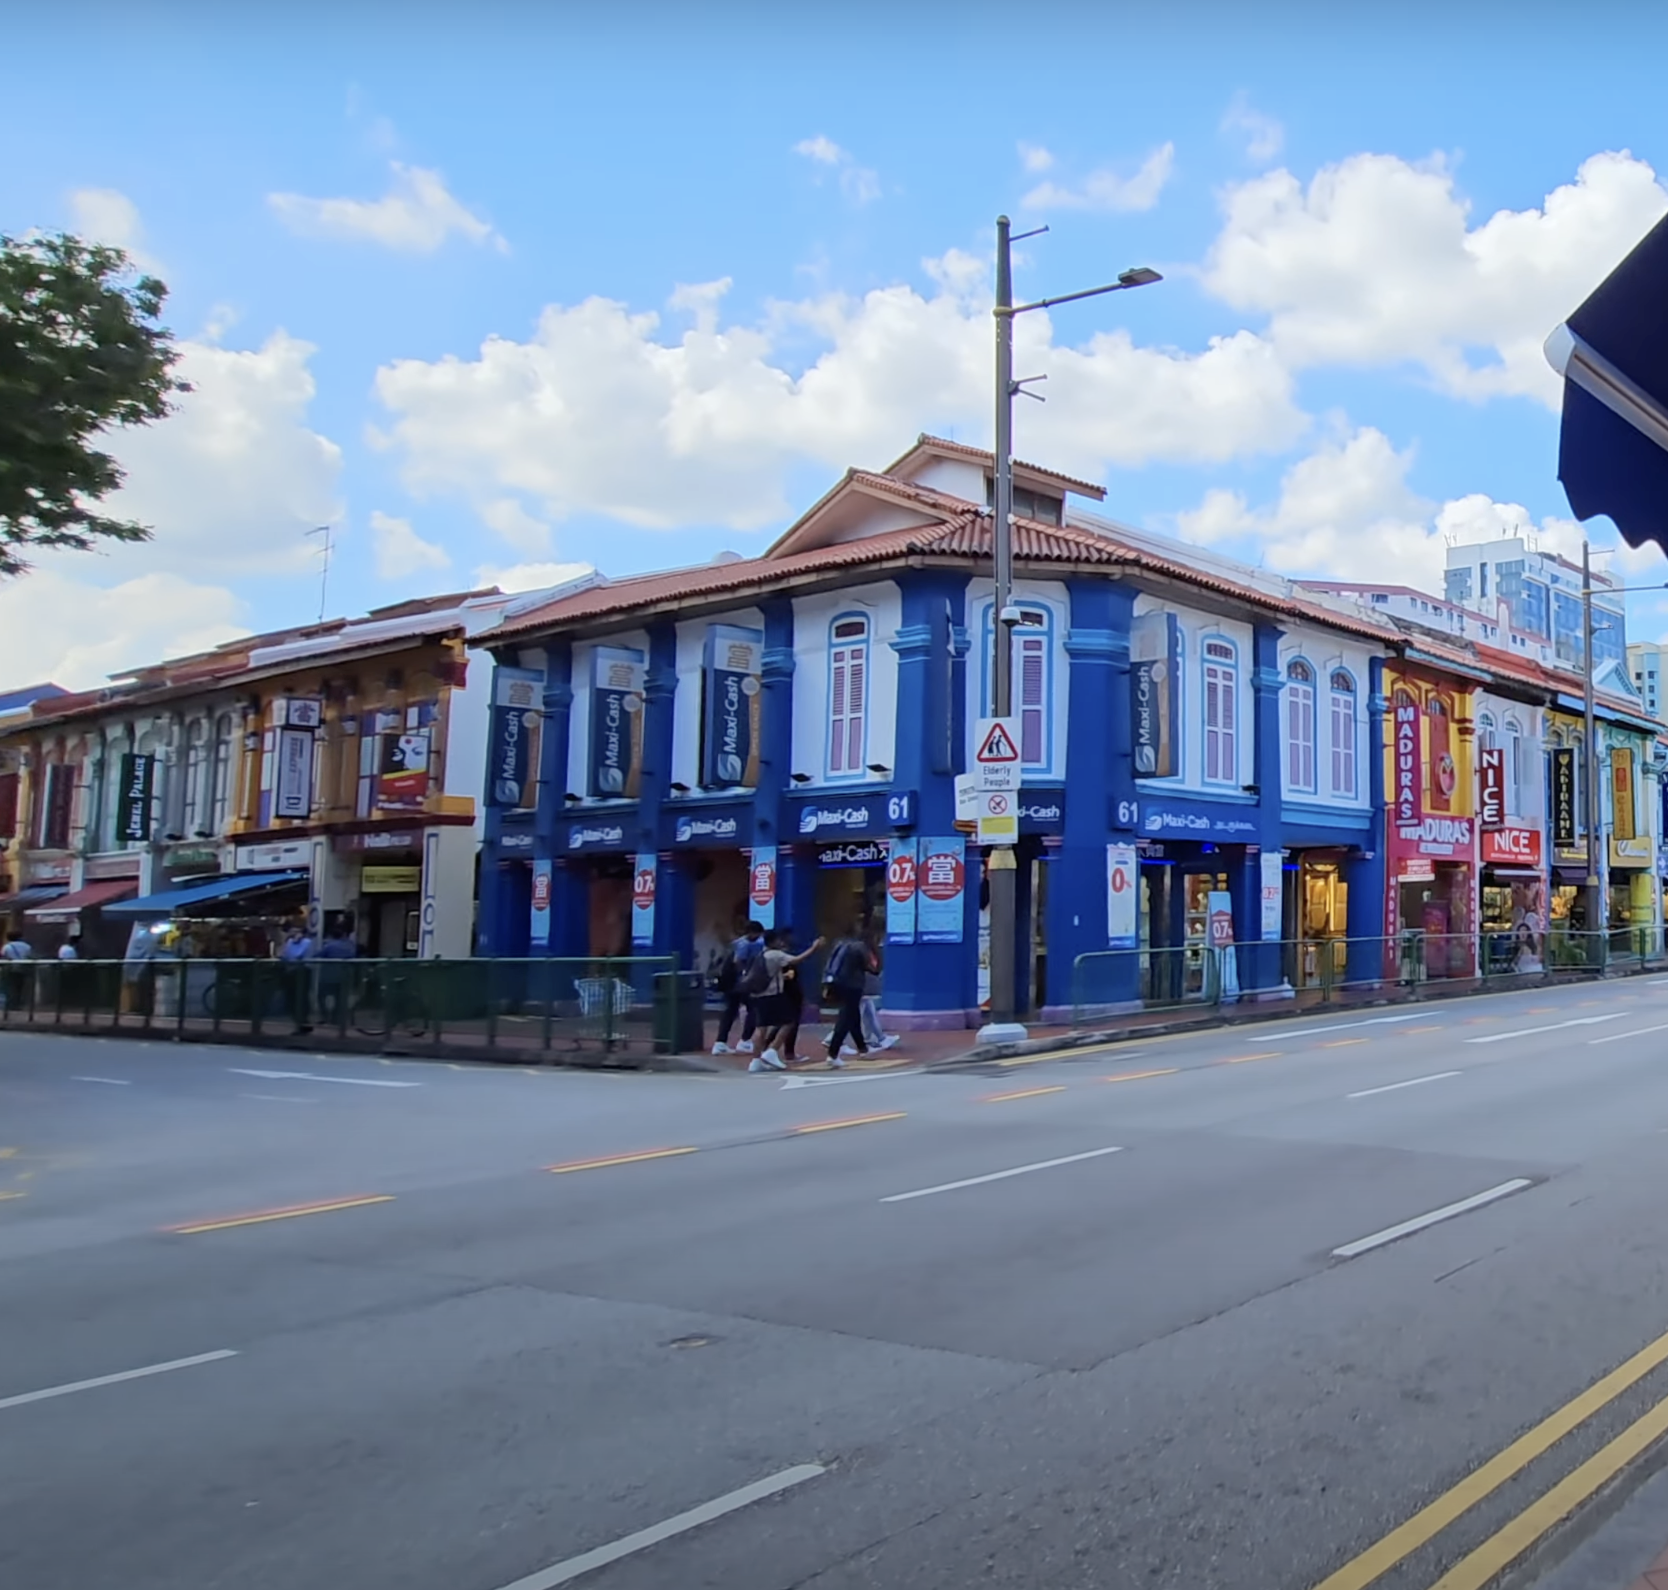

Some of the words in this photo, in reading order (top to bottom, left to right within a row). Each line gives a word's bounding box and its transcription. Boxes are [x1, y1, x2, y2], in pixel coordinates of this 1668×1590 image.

[723, 676, 739, 753] Maxi-Cash
[1138, 666, 1150, 744] Maxi-Cash
[604, 694, 620, 767] Maxi-Cash
[502, 711, 519, 779] Maxi-Cash
[983, 765, 1011, 776] Elderly
[1397, 707, 1415, 819] MADURAS
[984, 777, 1010, 788] People
[1482, 750, 1499, 822] NICE
[817, 806, 869, 825] Maxi-Cash
[888, 796, 909, 820] 61
[1118, 801, 1138, 823] 61
[1163, 813, 1210, 829] Maxi-Cash
[1401, 818, 1471, 844] MADURAS
[1494, 830, 1531, 854] NICE
